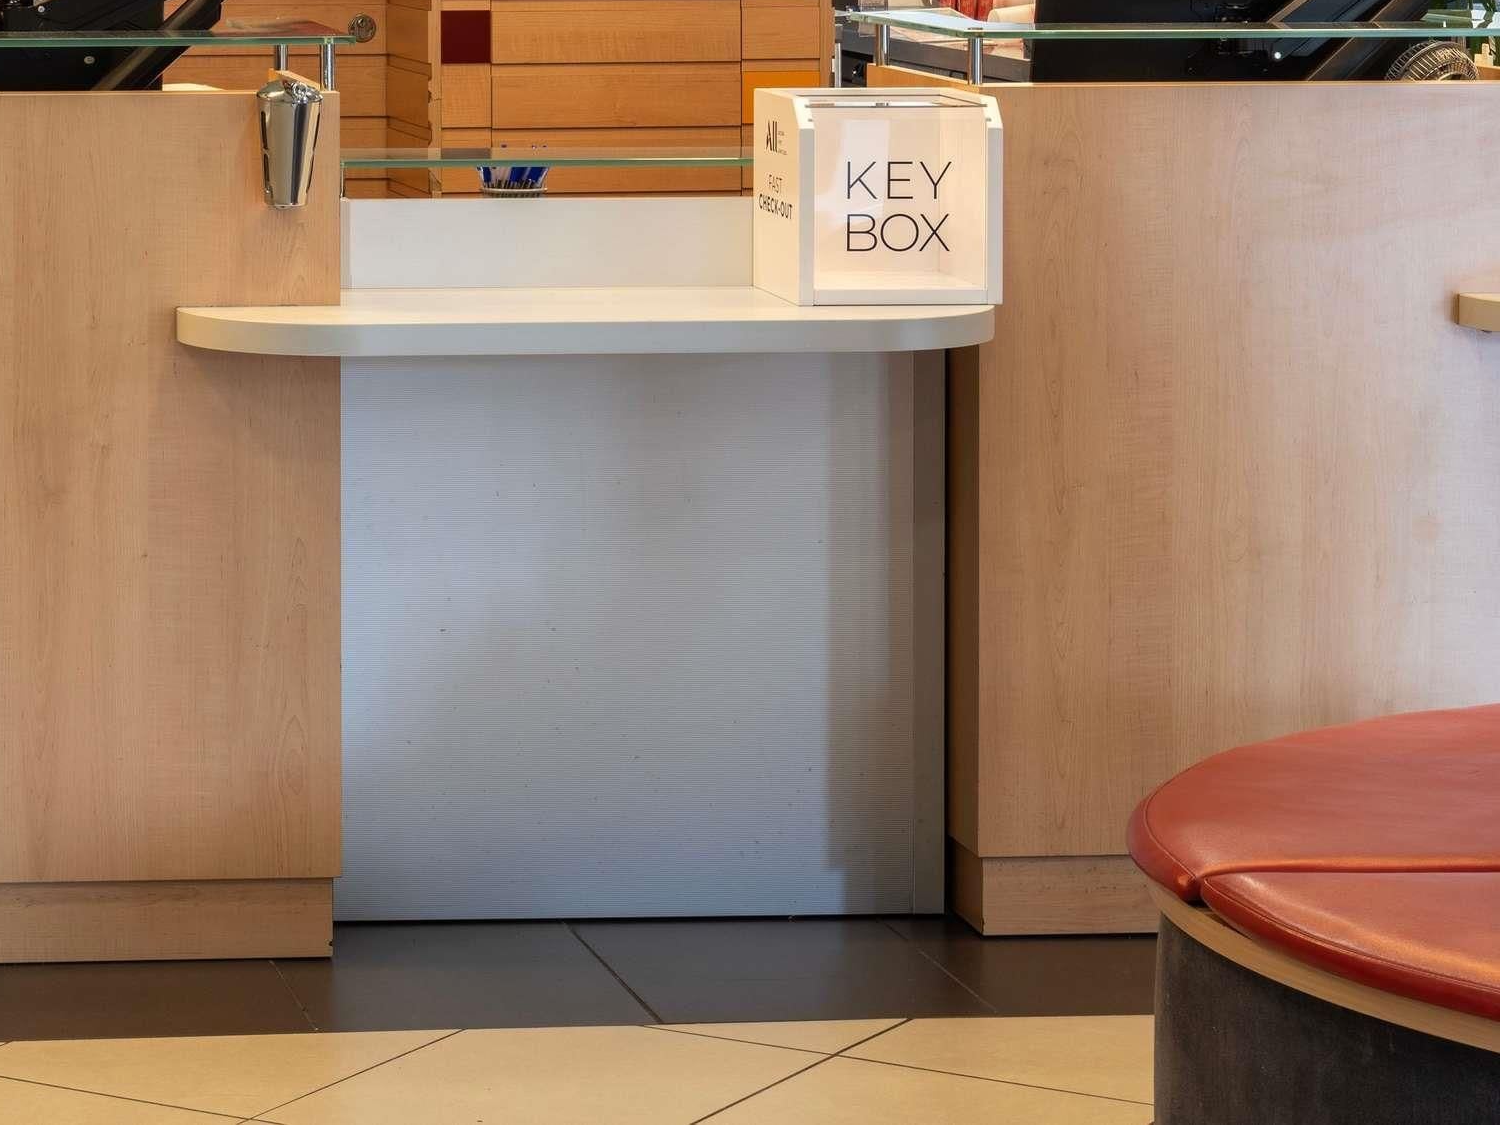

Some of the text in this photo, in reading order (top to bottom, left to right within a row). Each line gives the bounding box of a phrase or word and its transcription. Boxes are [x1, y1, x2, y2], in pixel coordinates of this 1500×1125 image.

[768, 174, 783, 193] FAST
[847, 161, 952, 200] KEY
[759, 193, 793, 220] CHECK-OUT
[847, 213, 950, 252] BOX
